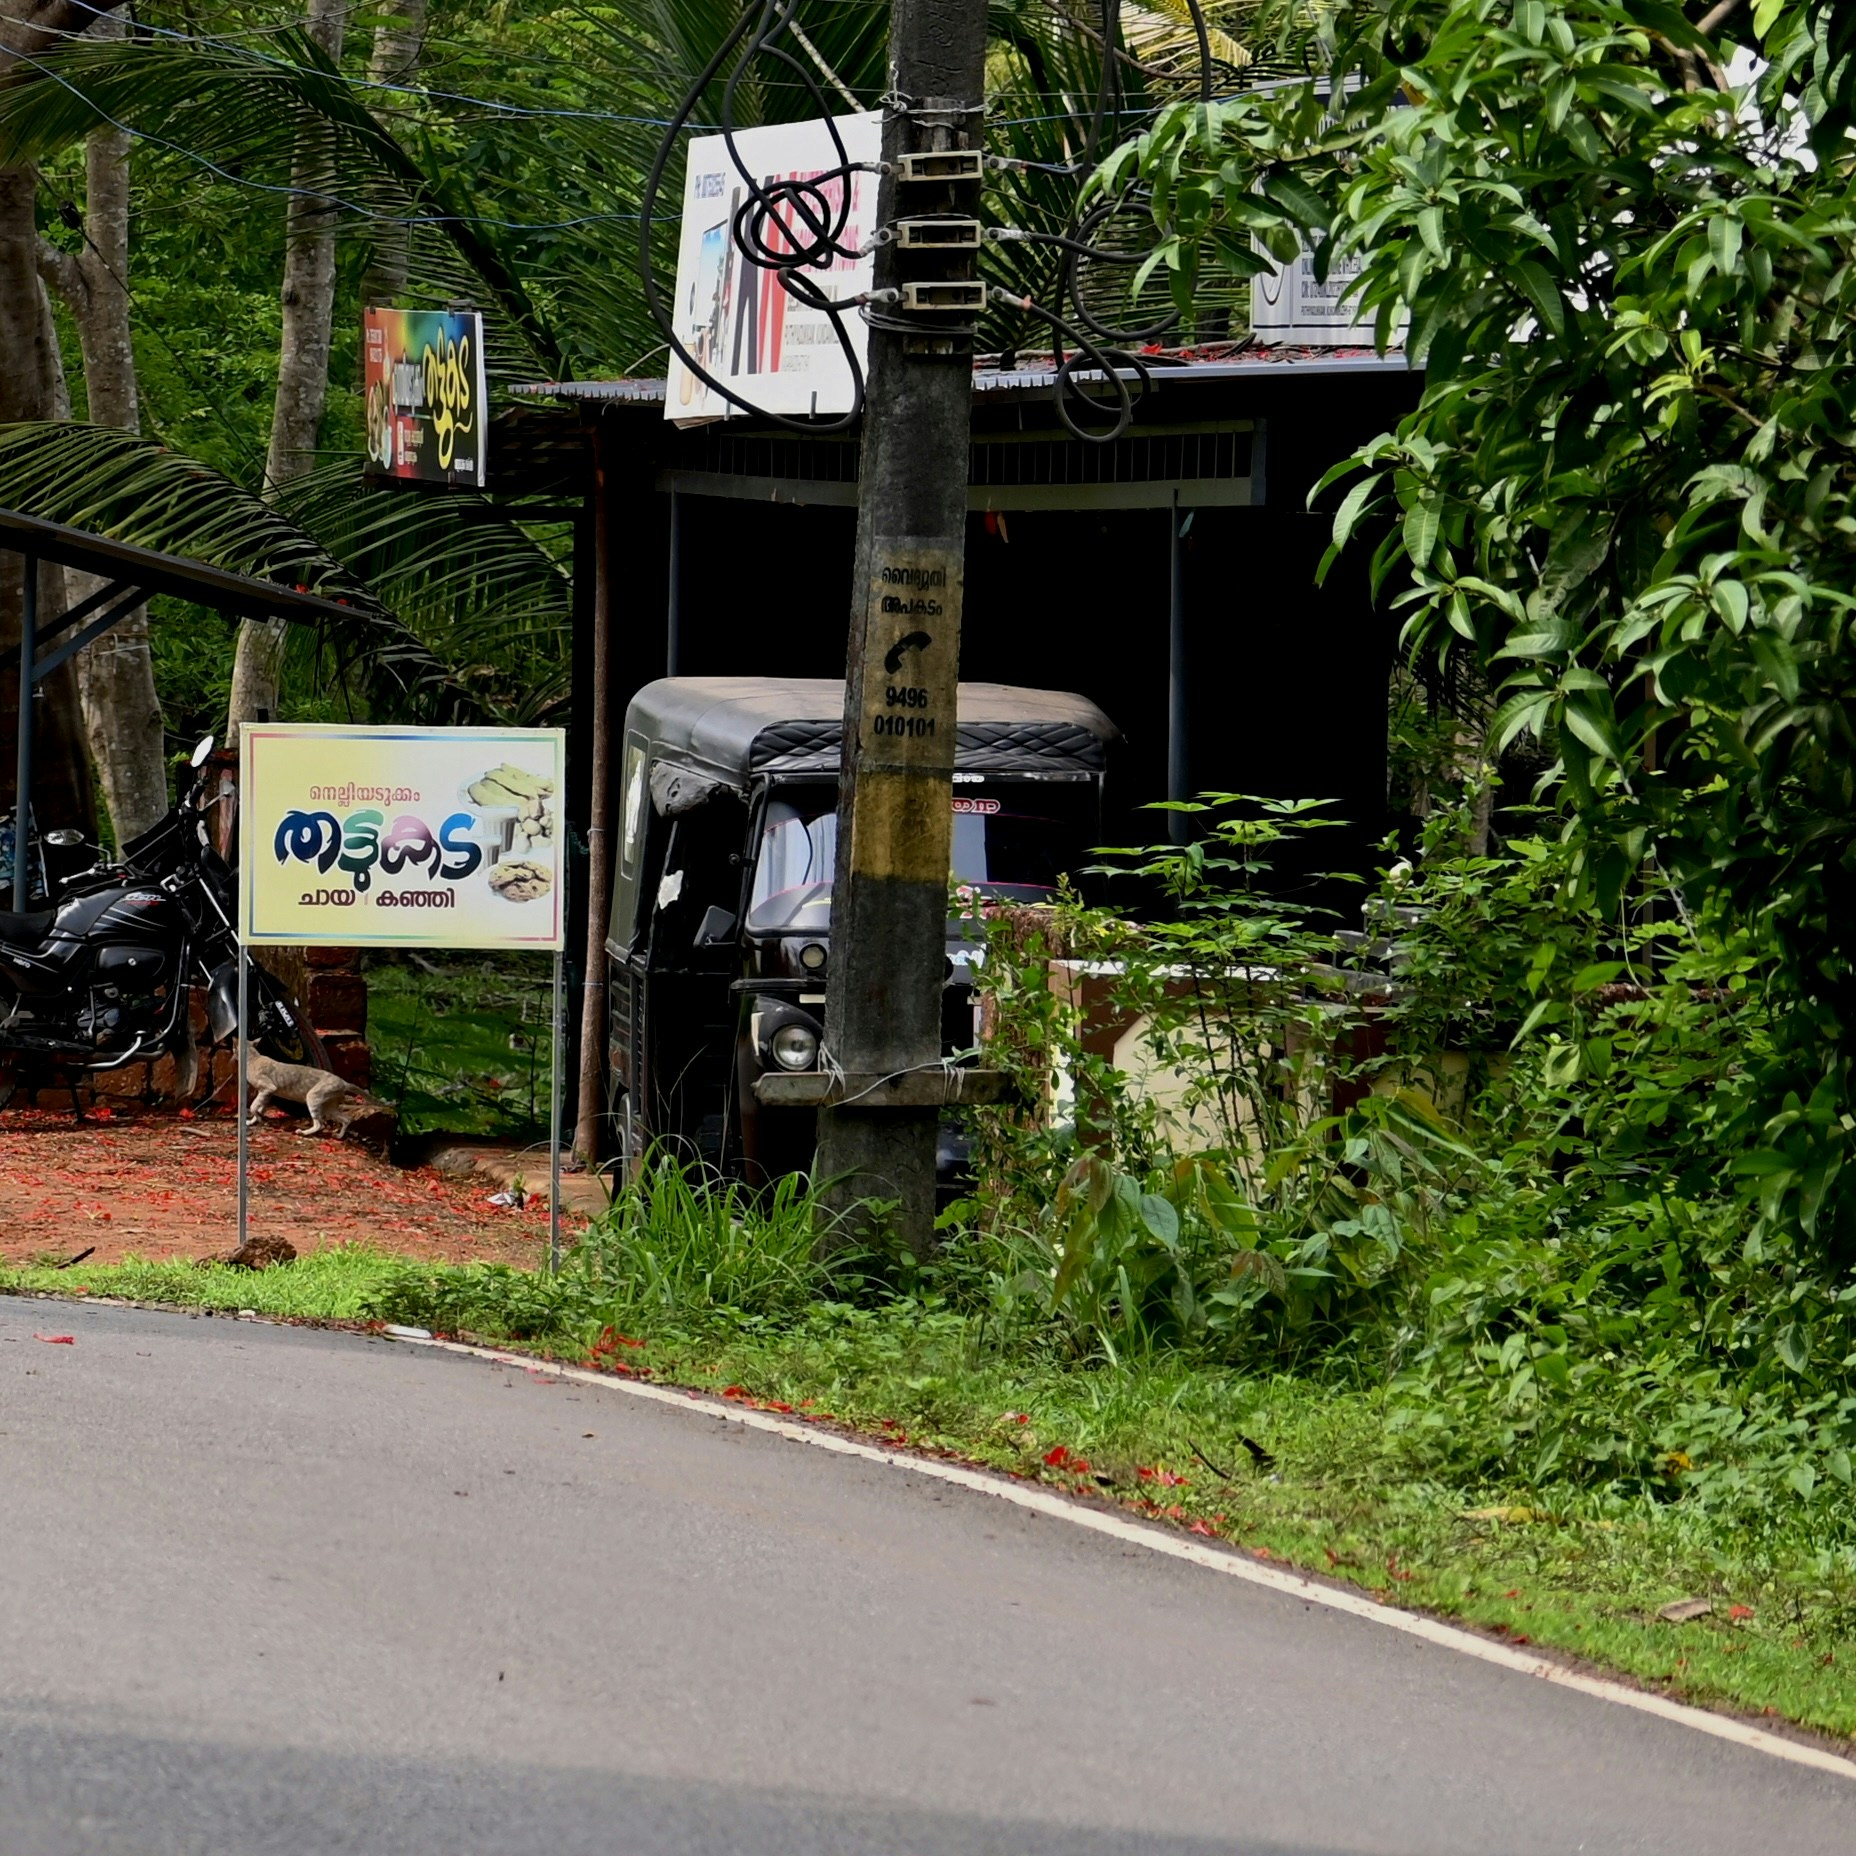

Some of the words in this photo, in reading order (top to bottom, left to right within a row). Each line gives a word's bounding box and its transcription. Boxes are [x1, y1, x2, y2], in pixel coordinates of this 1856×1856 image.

[881, 595, 943, 617] അപകടം
[885, 685, 929, 709] 9496
[873, 714, 936, 738] 010101
[309, 781, 421, 808] നെല്ലിയടുക്കം
[273, 808, 483, 894] തട്ടുകട
[297, 888, 356, 907] ചായ
[375, 887, 456, 909] കഞ്ഞി
